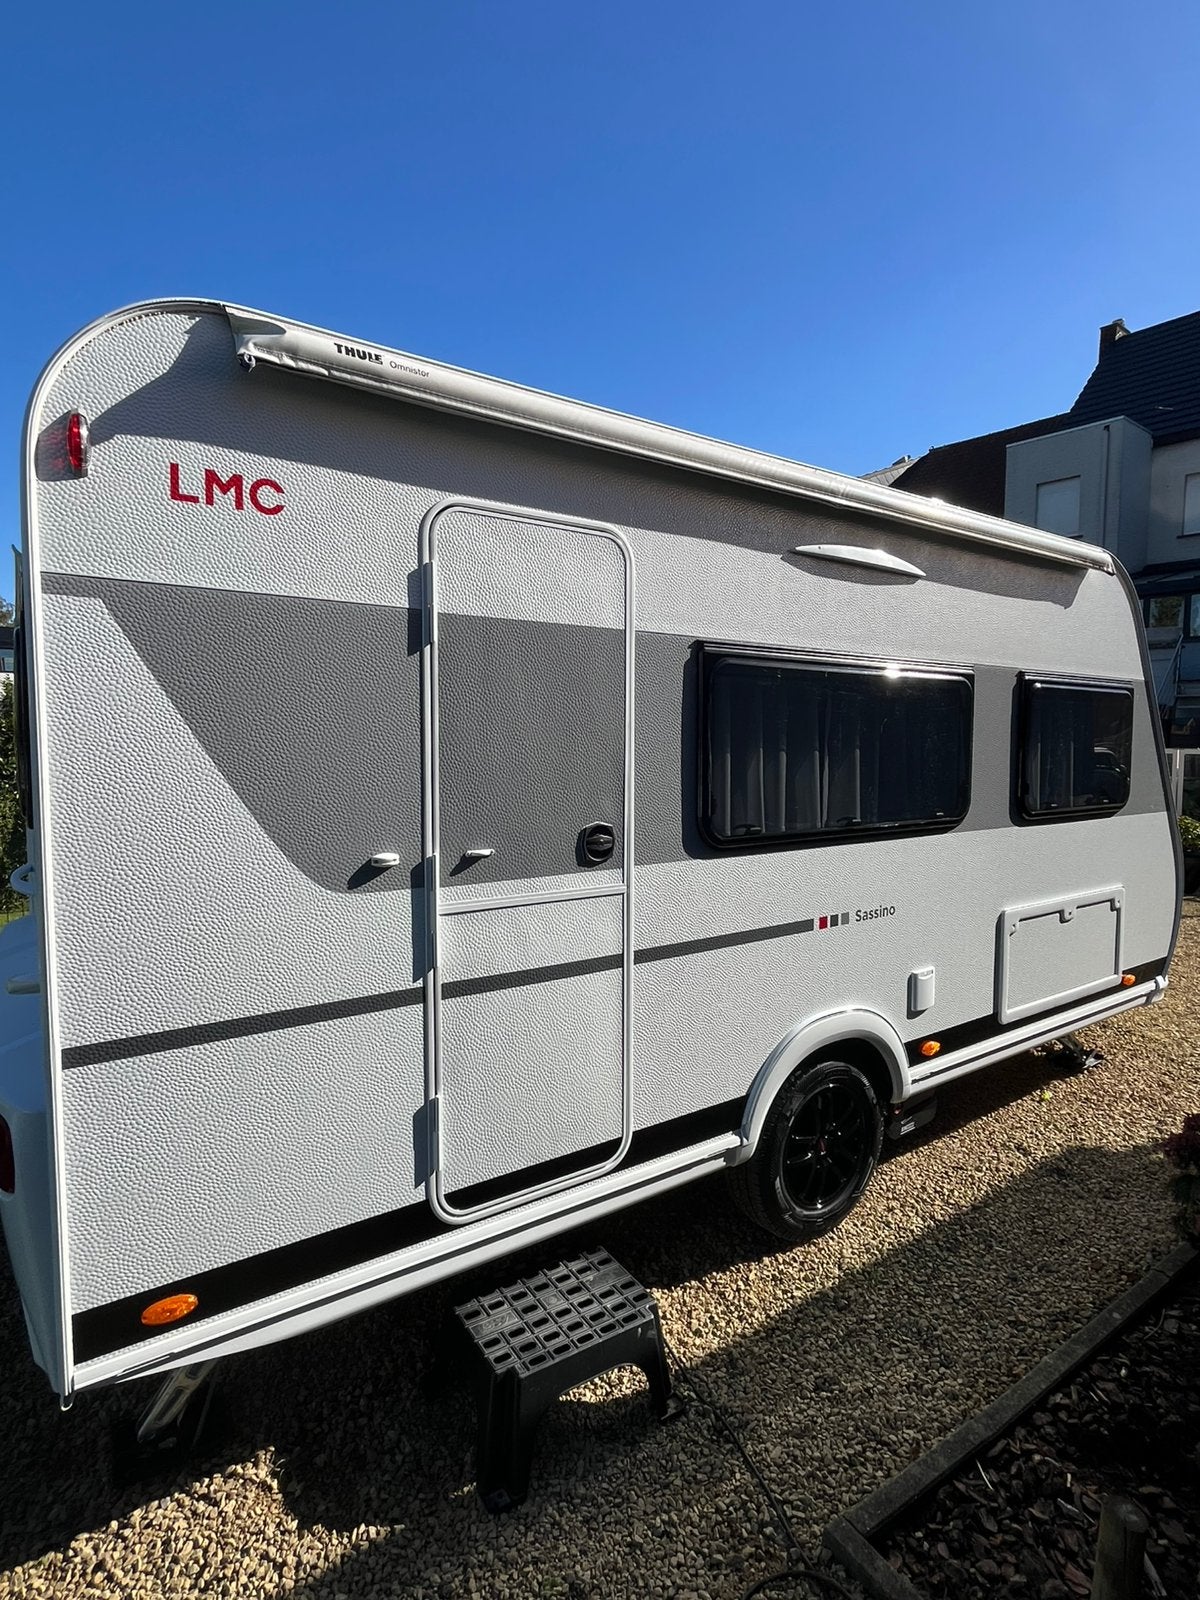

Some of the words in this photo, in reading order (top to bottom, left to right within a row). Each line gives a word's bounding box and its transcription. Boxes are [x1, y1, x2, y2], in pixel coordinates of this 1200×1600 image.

[334, 343, 383, 365] THULE
[389, 361, 430, 378] Omnistor
[170, 462, 286, 516] LMC
[855, 905, 896, 922] Sassino
